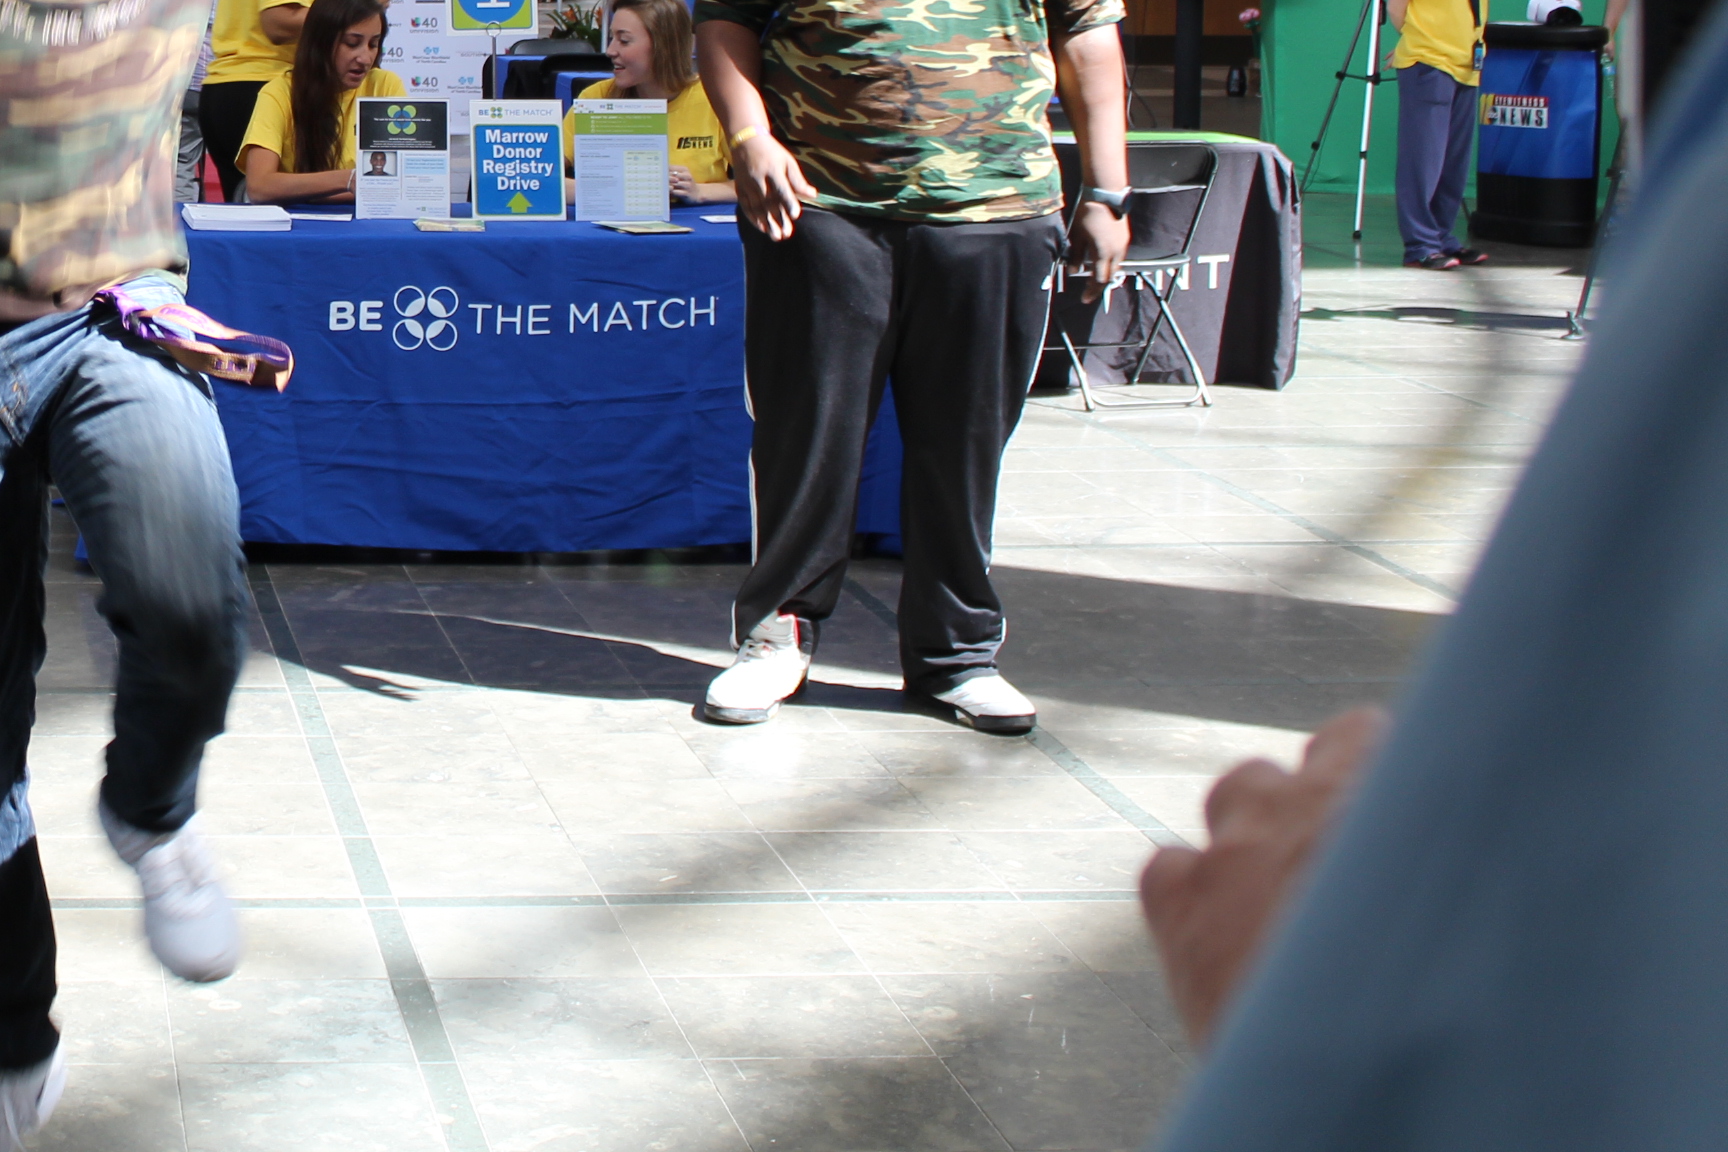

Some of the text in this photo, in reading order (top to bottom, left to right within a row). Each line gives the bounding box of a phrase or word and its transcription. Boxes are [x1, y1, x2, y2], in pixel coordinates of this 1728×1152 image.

[422, 17, 438, 28] 40
[387, 47, 403, 58] 40
[422, 77, 438, 88] 40
[523, 108, 553, 116] MATCH
[1499, 107, 1544, 127] NEWS
[485, 129, 548, 144] Marrow
[492, 145, 542, 159] Donor
[482, 160, 553, 176] Registry
[497, 177, 540, 191] Drive
[329, 295, 716, 335] BE THE MATCH
